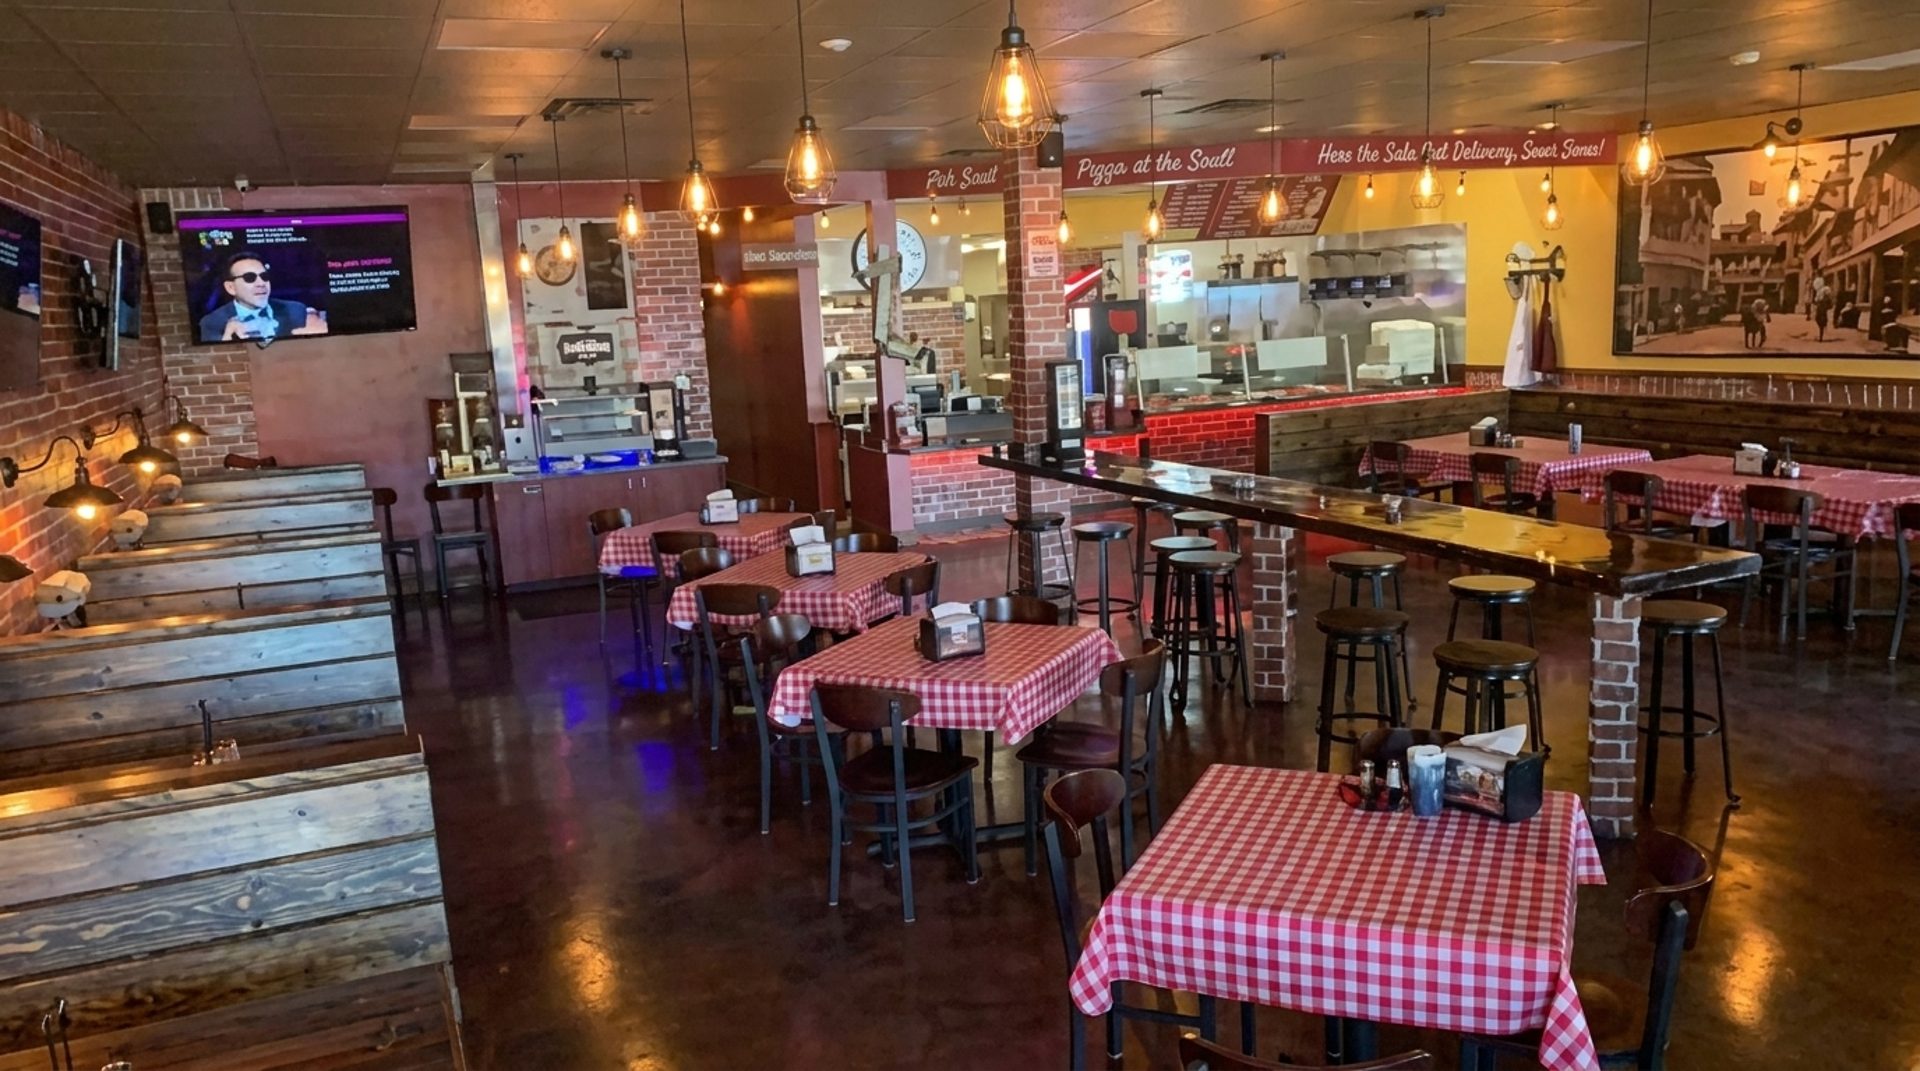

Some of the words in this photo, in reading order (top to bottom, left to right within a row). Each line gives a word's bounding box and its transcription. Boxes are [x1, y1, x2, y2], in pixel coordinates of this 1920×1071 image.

[1133, 154, 1151, 174] at
[1155, 150, 1182, 172] the
[1357, 142, 1380, 163] the
